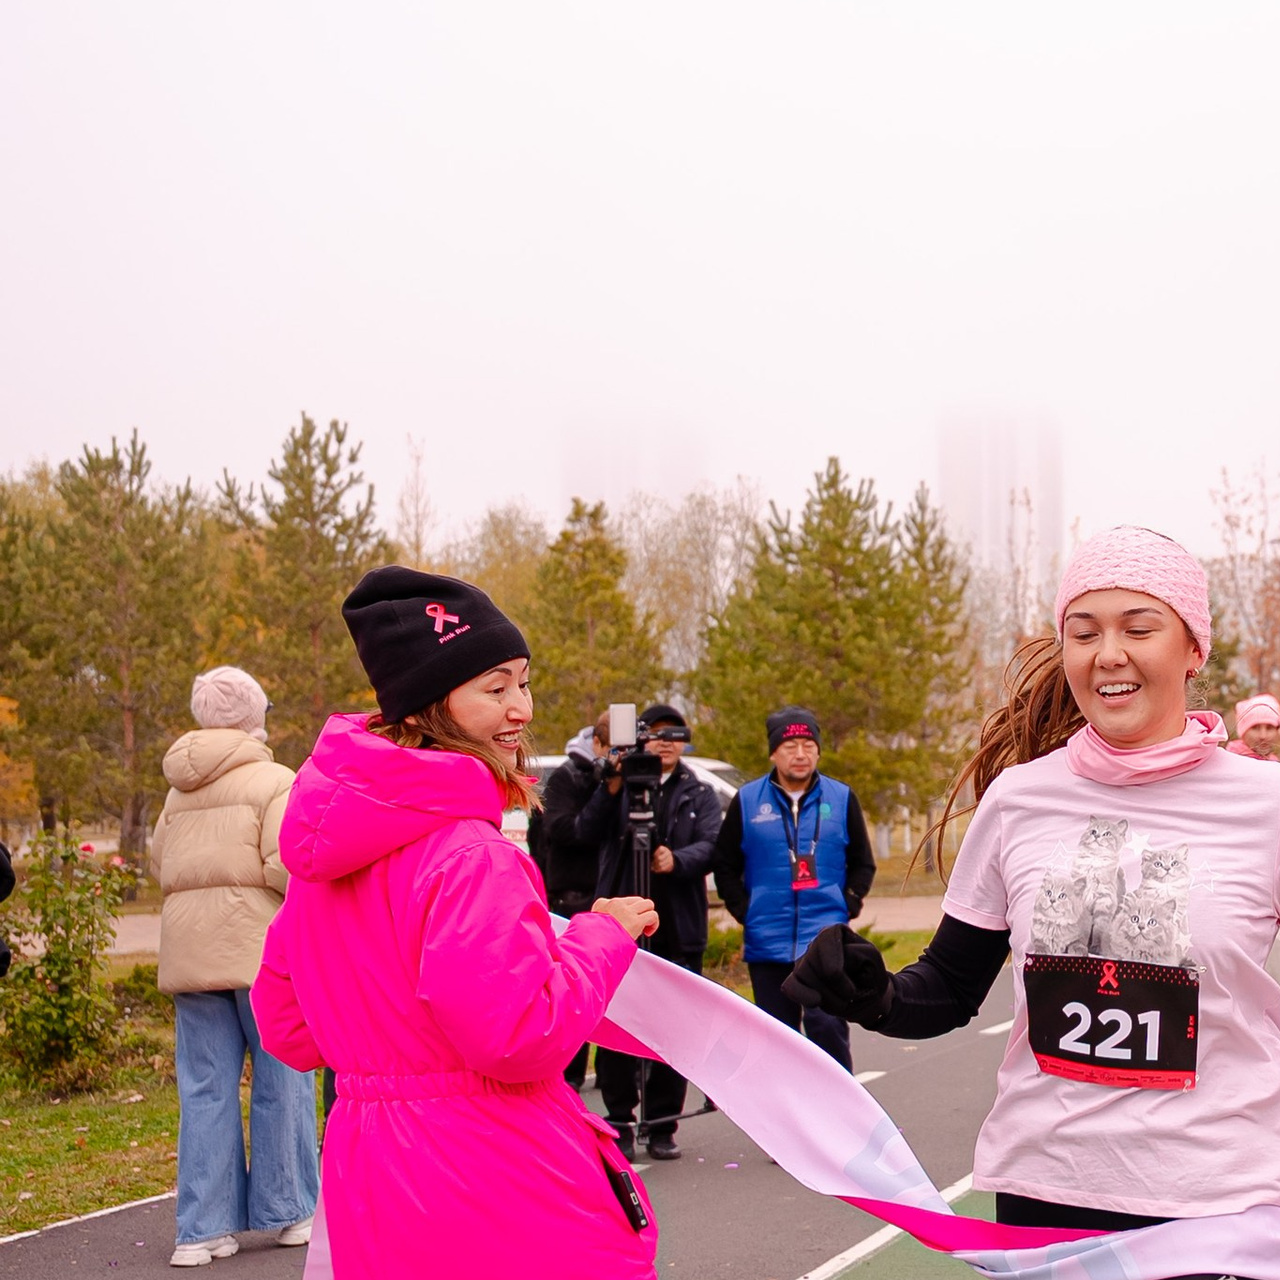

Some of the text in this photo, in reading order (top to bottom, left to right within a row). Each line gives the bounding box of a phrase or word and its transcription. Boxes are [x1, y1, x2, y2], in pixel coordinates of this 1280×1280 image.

[439, 625, 470, 643] Pink Run
[1059, 1002, 1160, 1061] 221
